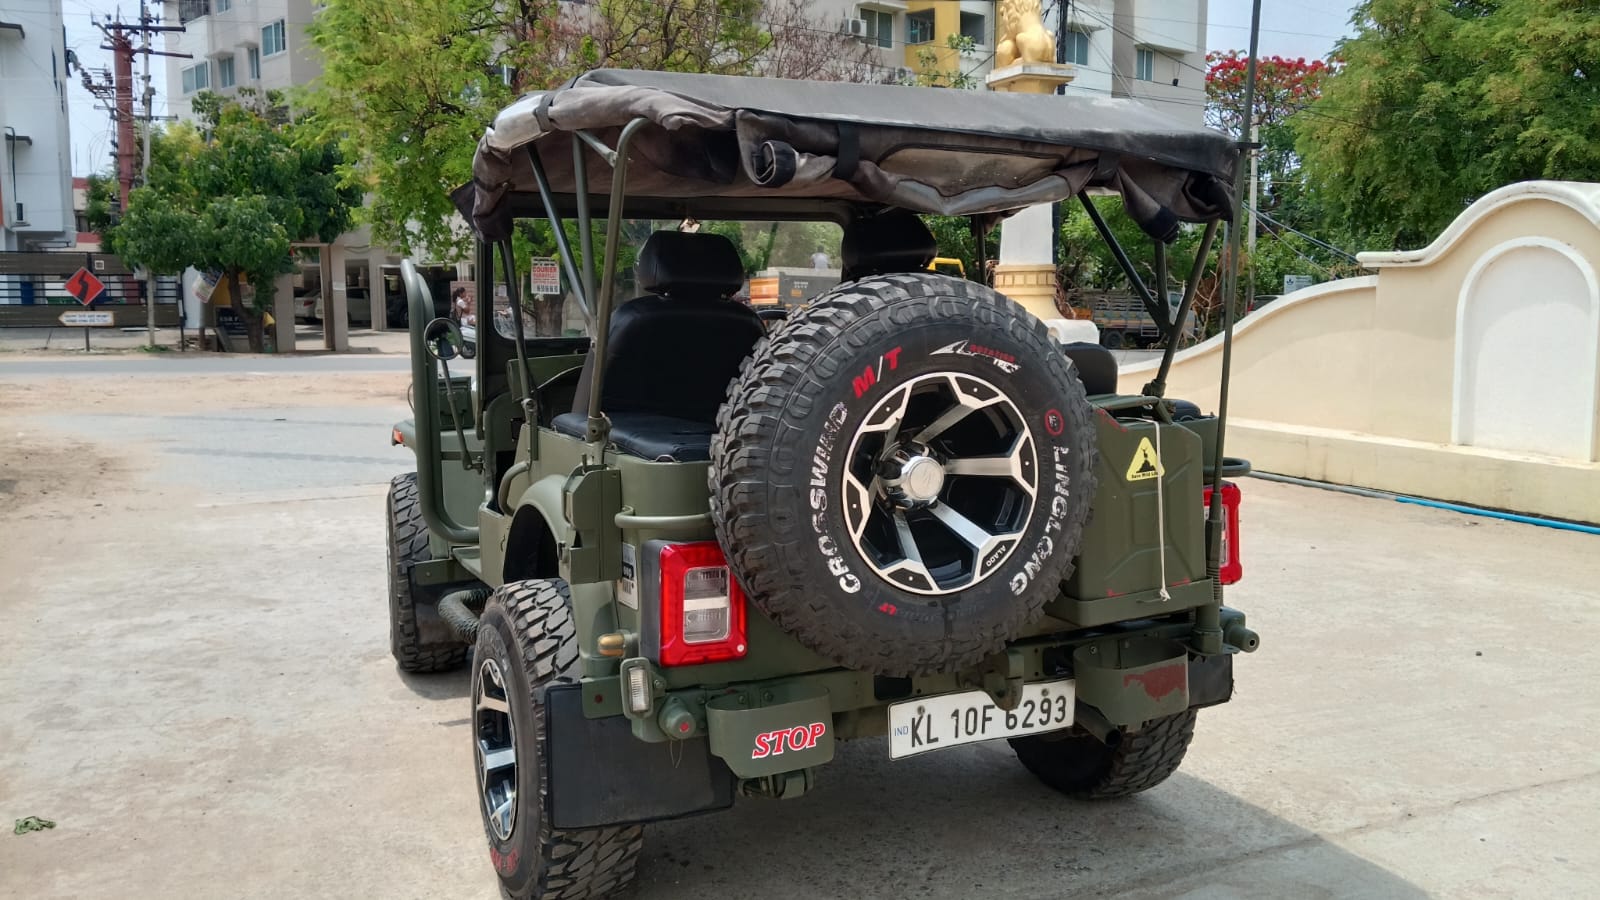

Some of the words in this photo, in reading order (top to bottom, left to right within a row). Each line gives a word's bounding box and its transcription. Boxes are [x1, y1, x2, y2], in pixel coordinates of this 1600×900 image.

[852, 345, 902, 399] M/T
[752, 722, 826, 759] STOP
[894, 725, 909, 737] IND
[911, 713, 939, 748] KL
[950, 704, 995, 739] 10F
[1005, 695, 1067, 730] 6293
